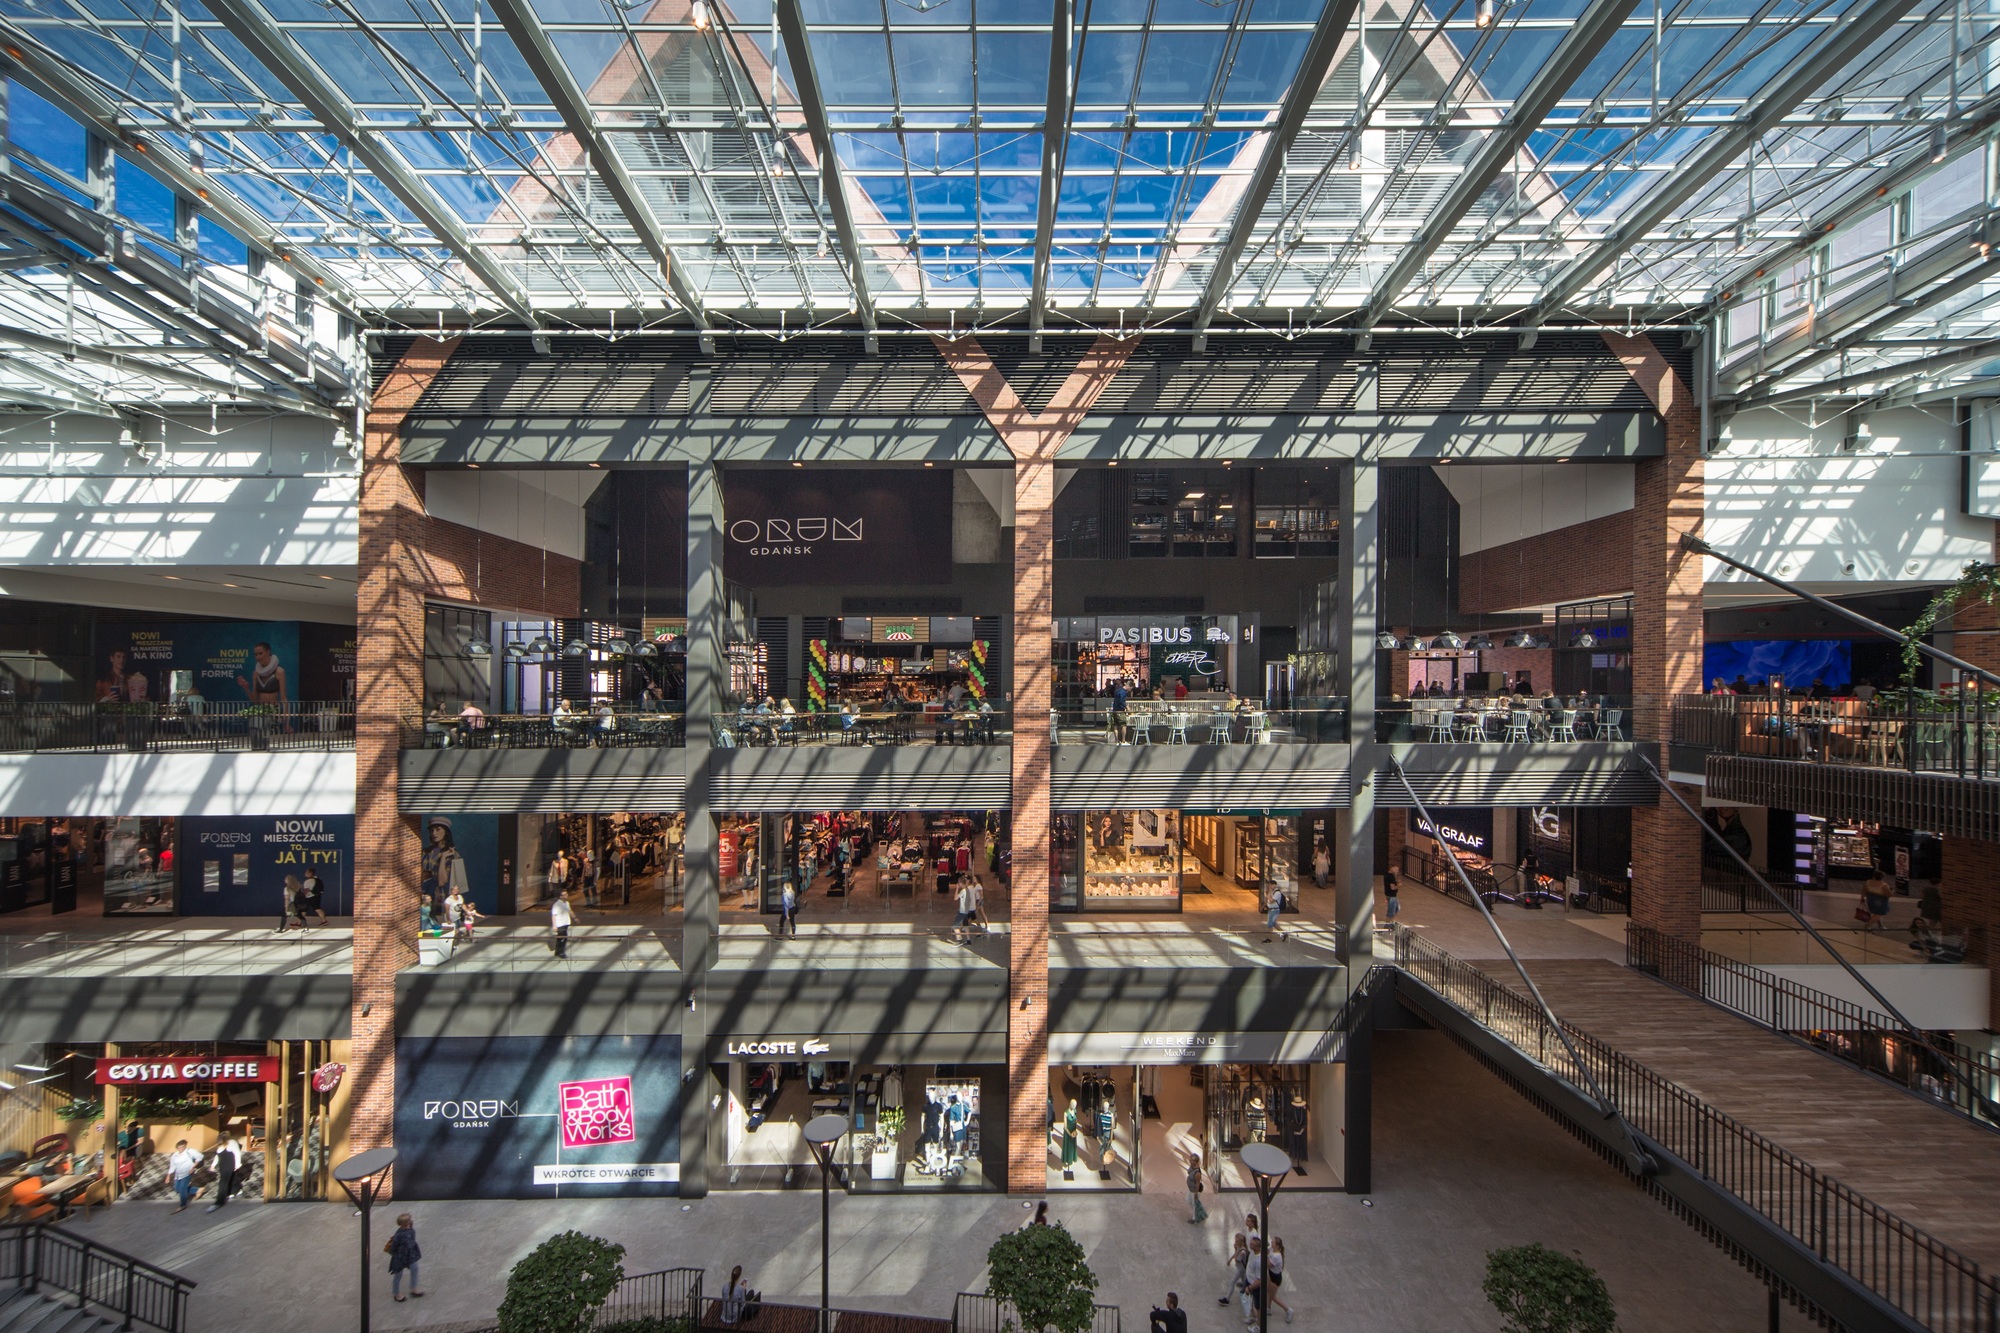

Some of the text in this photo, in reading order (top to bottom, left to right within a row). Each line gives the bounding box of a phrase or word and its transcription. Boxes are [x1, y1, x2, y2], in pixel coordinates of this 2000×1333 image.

[724, 518, 862, 543] ORUM
[750, 545, 812, 556] GDAŃSK
[131, 632, 160, 640] NOWI
[1100, 627, 1192, 643] PASIBUS
[220, 649, 249, 657] NOWI
[201, 670, 234, 679] FORMĘ
[275, 820, 323, 833] NOWI
[200, 833, 251, 843] FORUM
[264, 834, 335, 843] MIESZCZANIE
[1441, 826, 1484, 848] GRAAF
[275, 851, 337, 864] JA I TY!
[1143, 1037, 1217, 1046] WEEKEND
[728, 1042, 796, 1055] LACOSTE
[1163, 1048, 1196, 1057] MaxMara
[108, 1062, 259, 1081] COSTA COFFEE
[321, 1063, 338, 1077] COSTA
[562, 1082, 630, 1112] Bath
[424, 1100, 518, 1119] FORUM
[453, 1120, 489, 1128] GDAŃSK
[565, 1120, 632, 1142] Works
[543, 1168, 655, 1179] WKRÓTCE OTWARCIE
